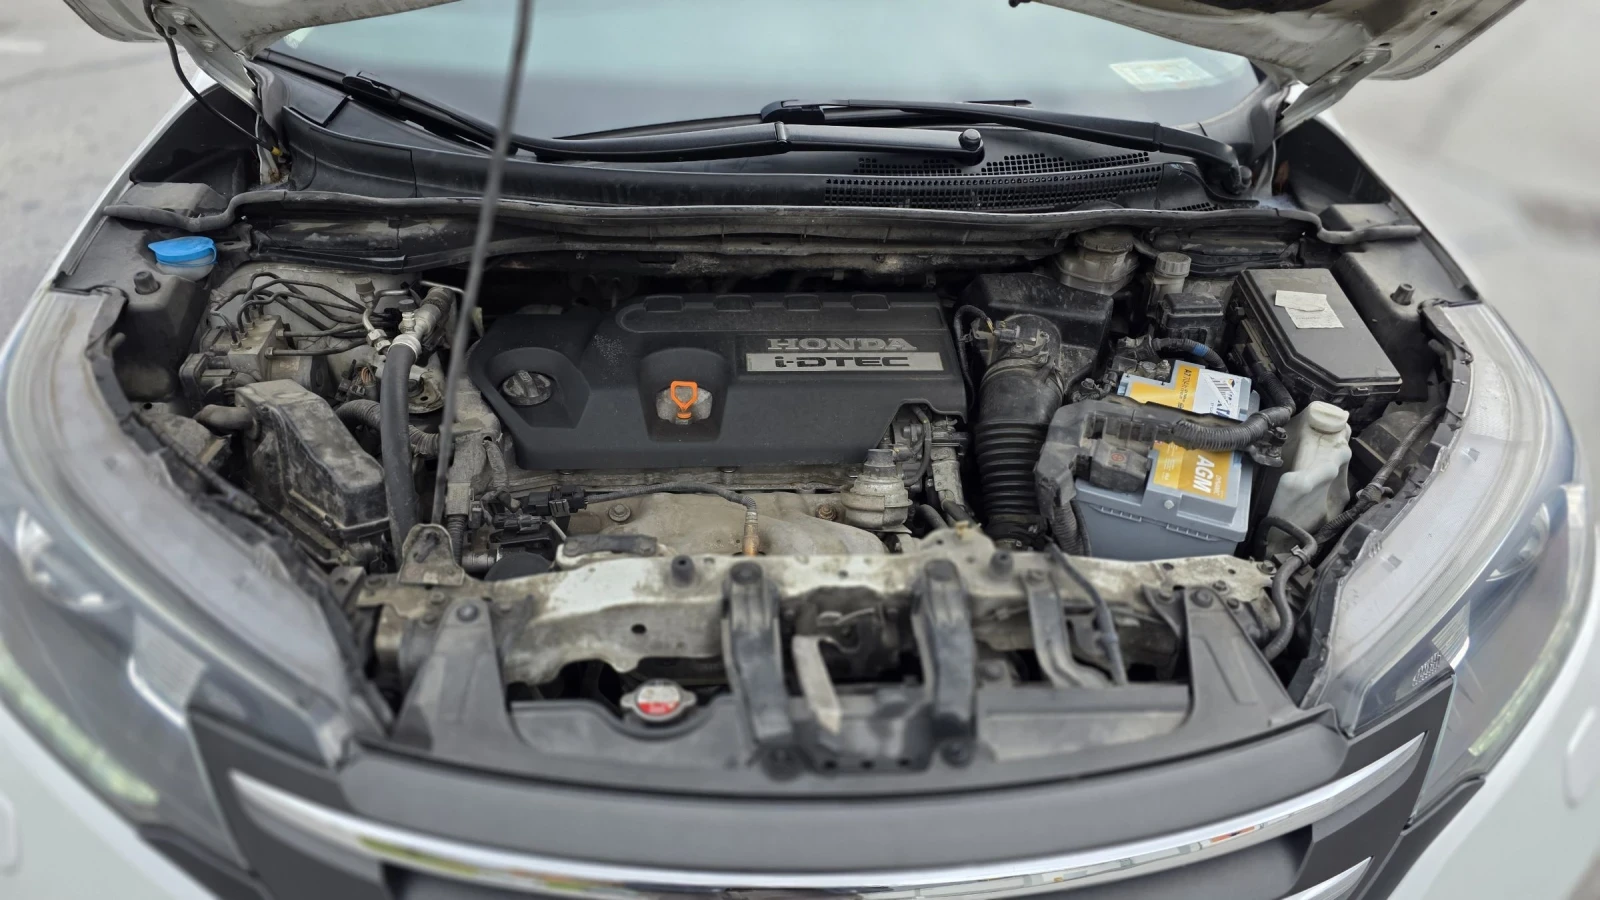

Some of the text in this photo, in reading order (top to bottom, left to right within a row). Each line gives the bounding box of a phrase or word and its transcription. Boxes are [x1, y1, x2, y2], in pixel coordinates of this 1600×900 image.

[767, 338, 917, 351] HONDA
[774, 356, 910, 368] i-DTEC
[1192, 454, 1214, 493] AGM
